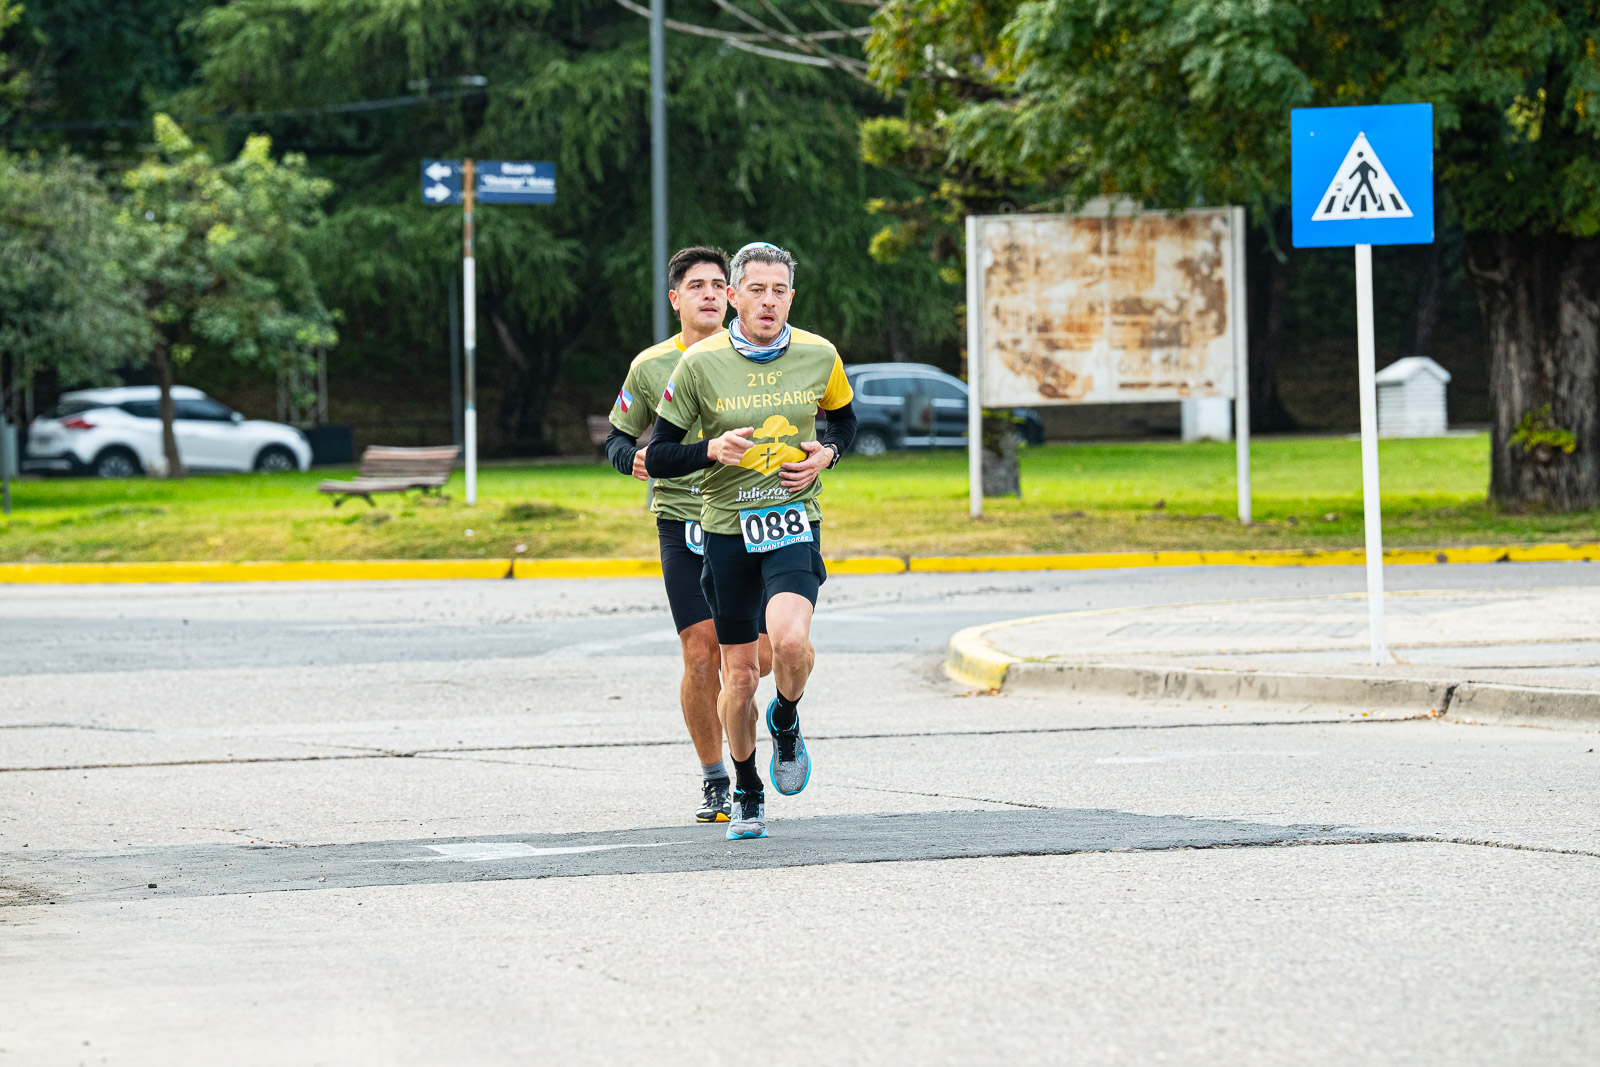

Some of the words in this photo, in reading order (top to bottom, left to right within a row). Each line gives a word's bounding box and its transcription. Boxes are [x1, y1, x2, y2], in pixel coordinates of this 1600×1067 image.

[715, 390, 816, 412] ANIVERSARIO
[745, 508, 805, 545] 088
[750, 540, 785, 552] DIAMANTE
[786, 535, 810, 545] CORRE
